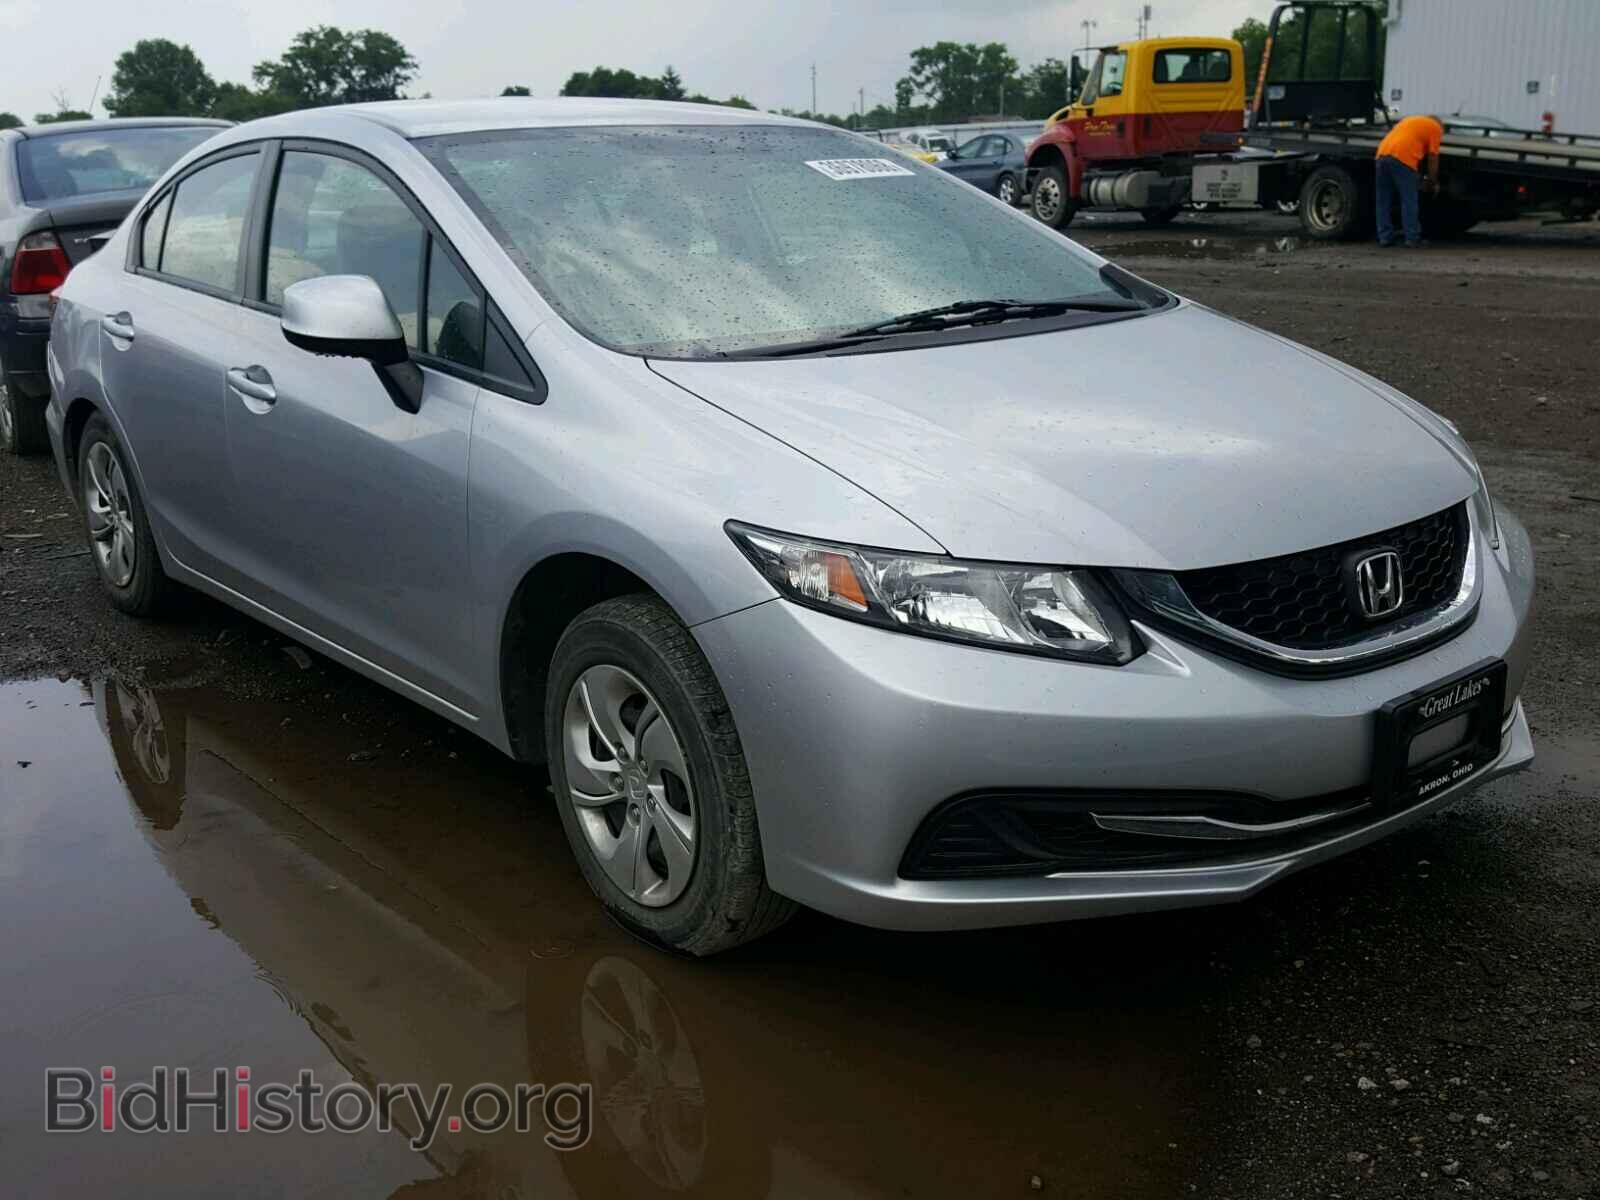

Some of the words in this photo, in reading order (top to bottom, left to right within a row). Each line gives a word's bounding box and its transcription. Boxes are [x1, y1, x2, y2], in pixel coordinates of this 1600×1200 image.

[1423, 690, 1454, 718] Great
[1454, 679, 1483, 705] Lakes
[1452, 763, 1473, 779] OHIO
